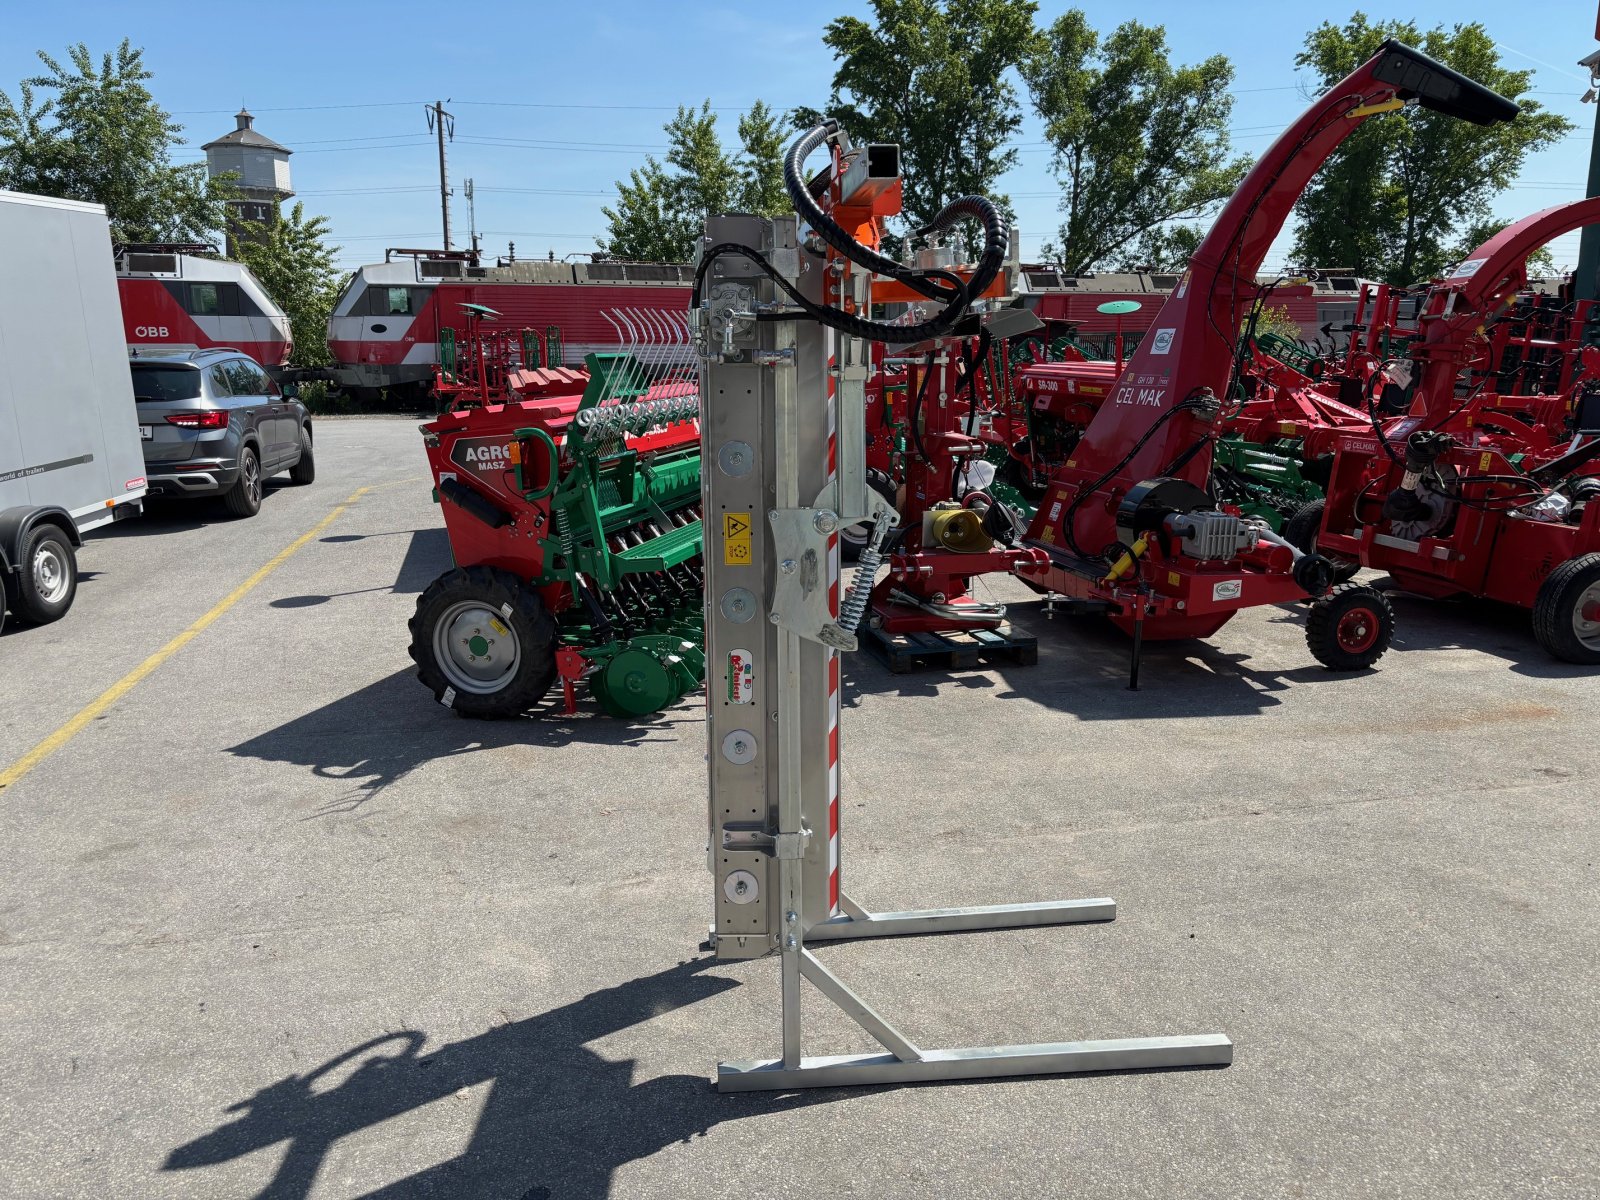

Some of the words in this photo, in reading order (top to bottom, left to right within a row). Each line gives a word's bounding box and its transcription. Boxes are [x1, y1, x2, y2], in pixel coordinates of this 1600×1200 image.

[135, 326, 169, 337] ÖBB
[1038, 380, 1058, 391] SR-300
[1116, 388, 1135, 407] ÇEL
[1136, 389, 1165, 407] MAK
[479, 461, 505, 470] MASZ
[17, 470, 24, 478] of
[25, 467, 45, 476] trailers
